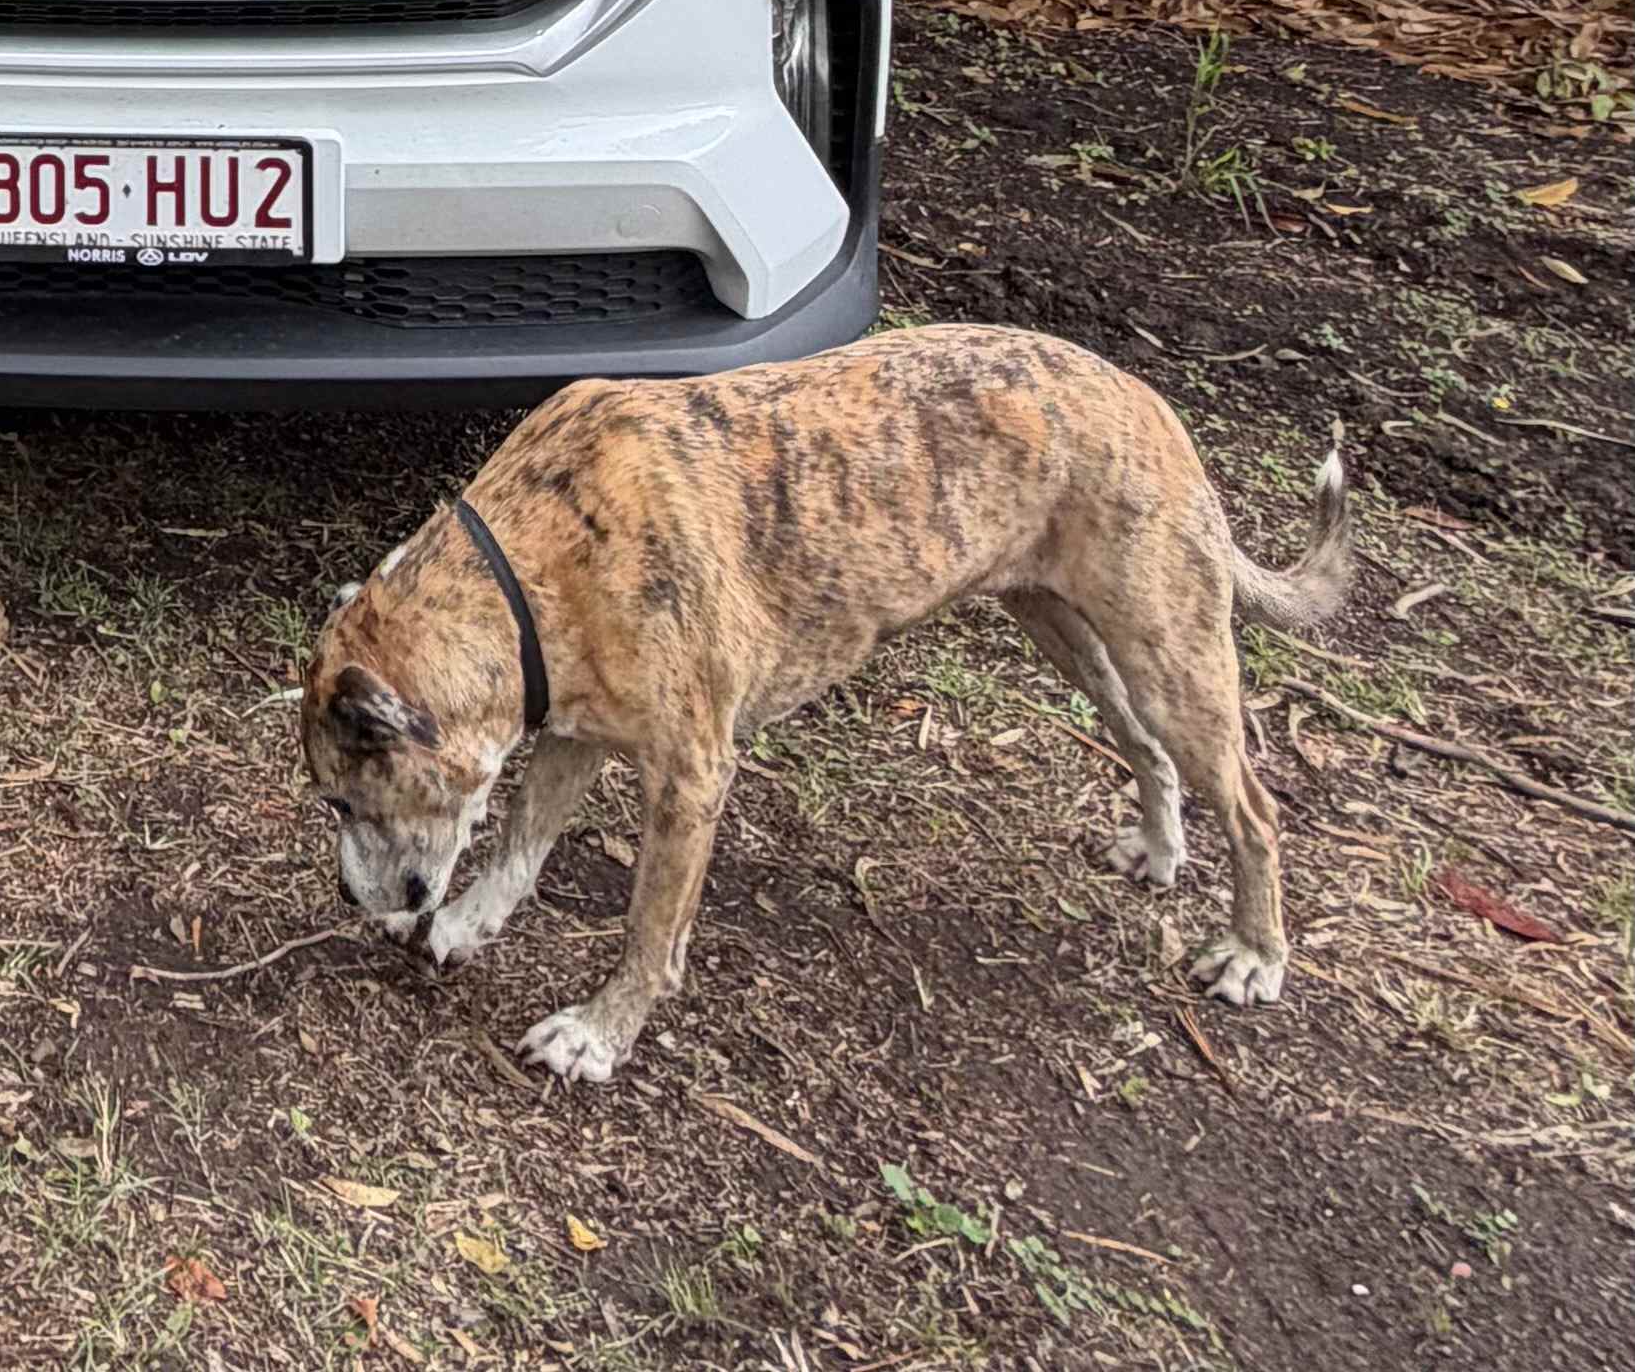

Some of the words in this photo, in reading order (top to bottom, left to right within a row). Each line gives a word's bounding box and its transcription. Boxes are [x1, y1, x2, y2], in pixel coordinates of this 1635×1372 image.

[146, 155, 293, 228] HU2
[235, 235, 292, 249] STATE
[68, 248, 126, 263] NORRIS
[168, 251, 209, 263] LDV
